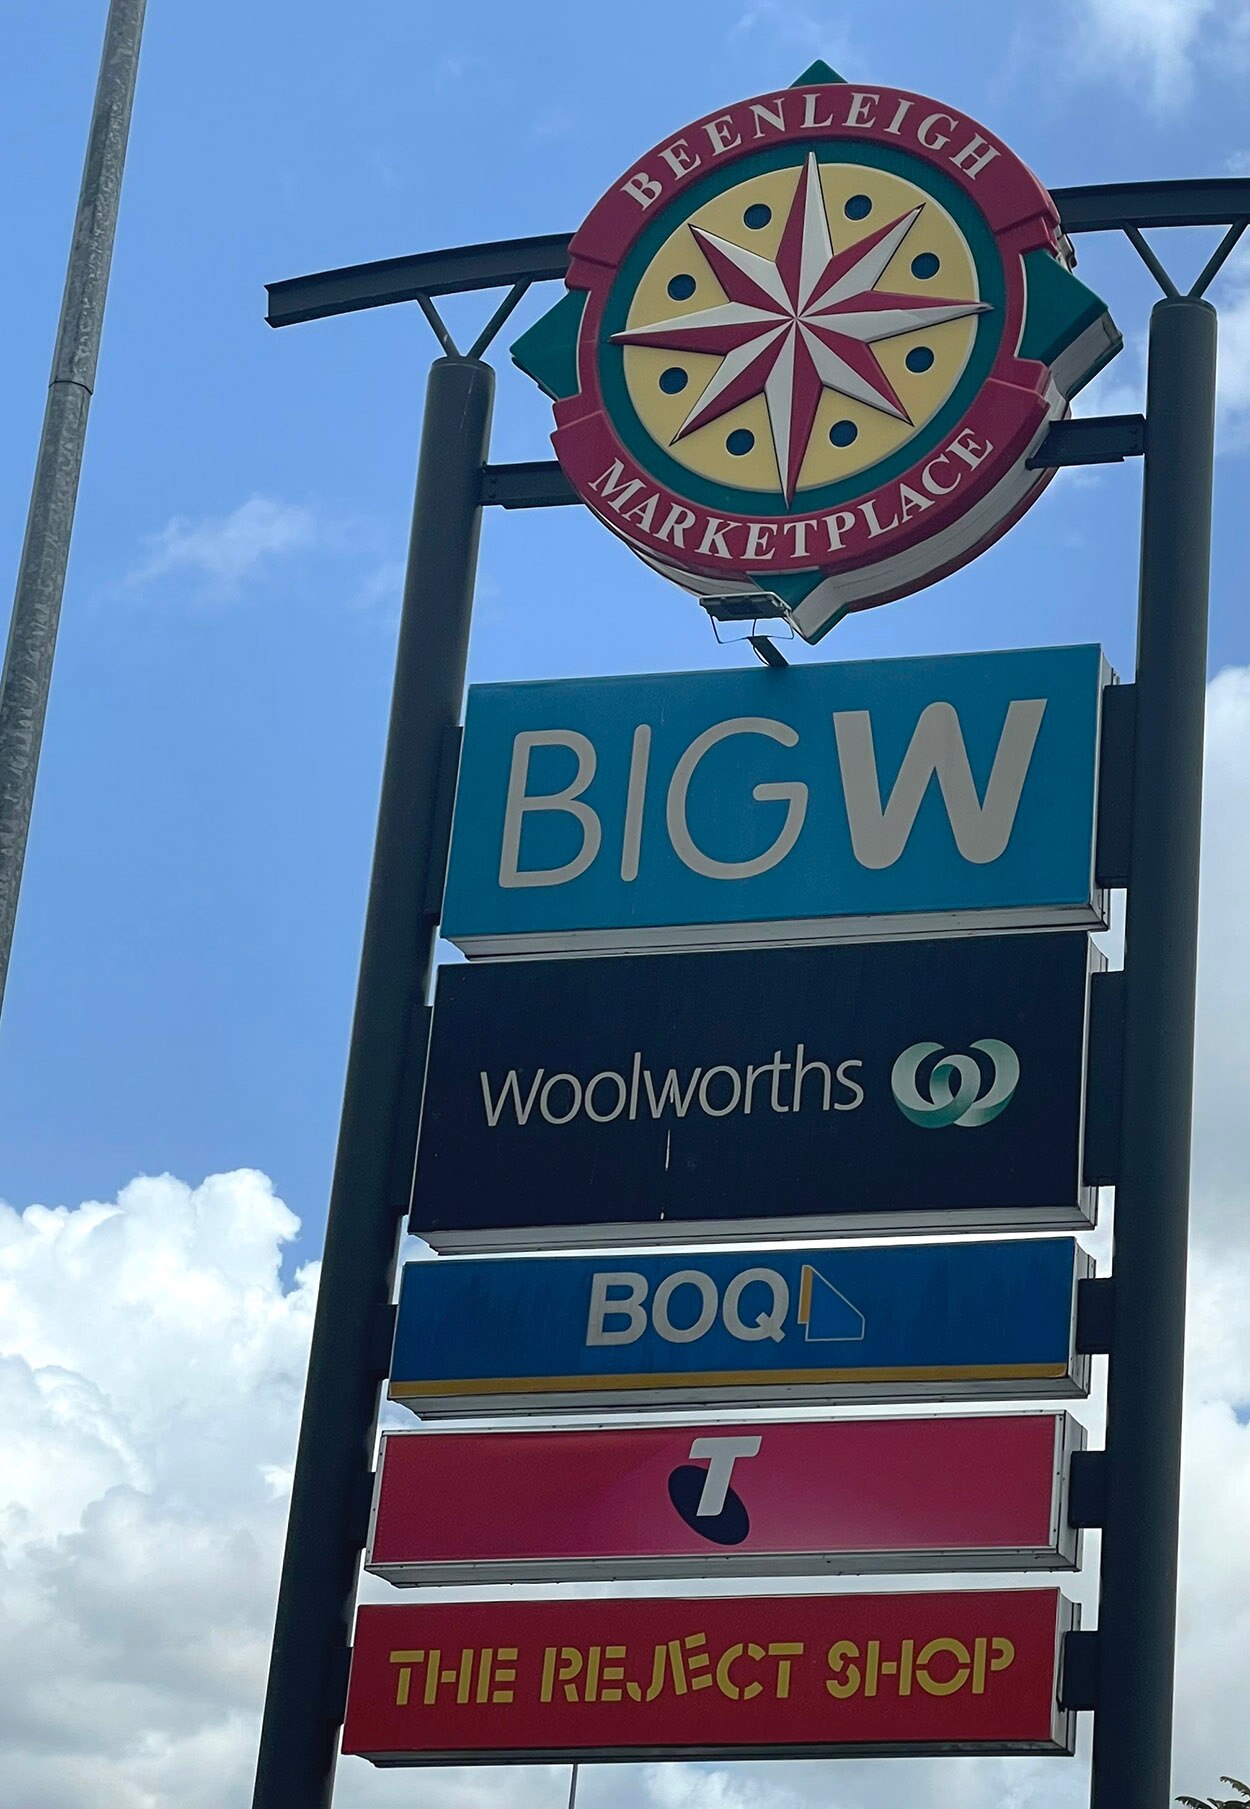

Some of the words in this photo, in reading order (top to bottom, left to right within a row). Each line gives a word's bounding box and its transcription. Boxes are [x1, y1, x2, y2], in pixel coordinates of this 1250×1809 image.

[619, 92, 1002, 211] BEENLEIGH
[588, 428, 994, 561] MARKETPLACE
[480, 1044, 864, 1127] Woolworths
[585, 1267, 789, 1347] BOQ
[687, 1435, 763, 1517] T
[389, 1647, 518, 1705] THE
[540, 1632, 804, 1702] REJECT
[825, 1637, 1015, 1699] SHOP
